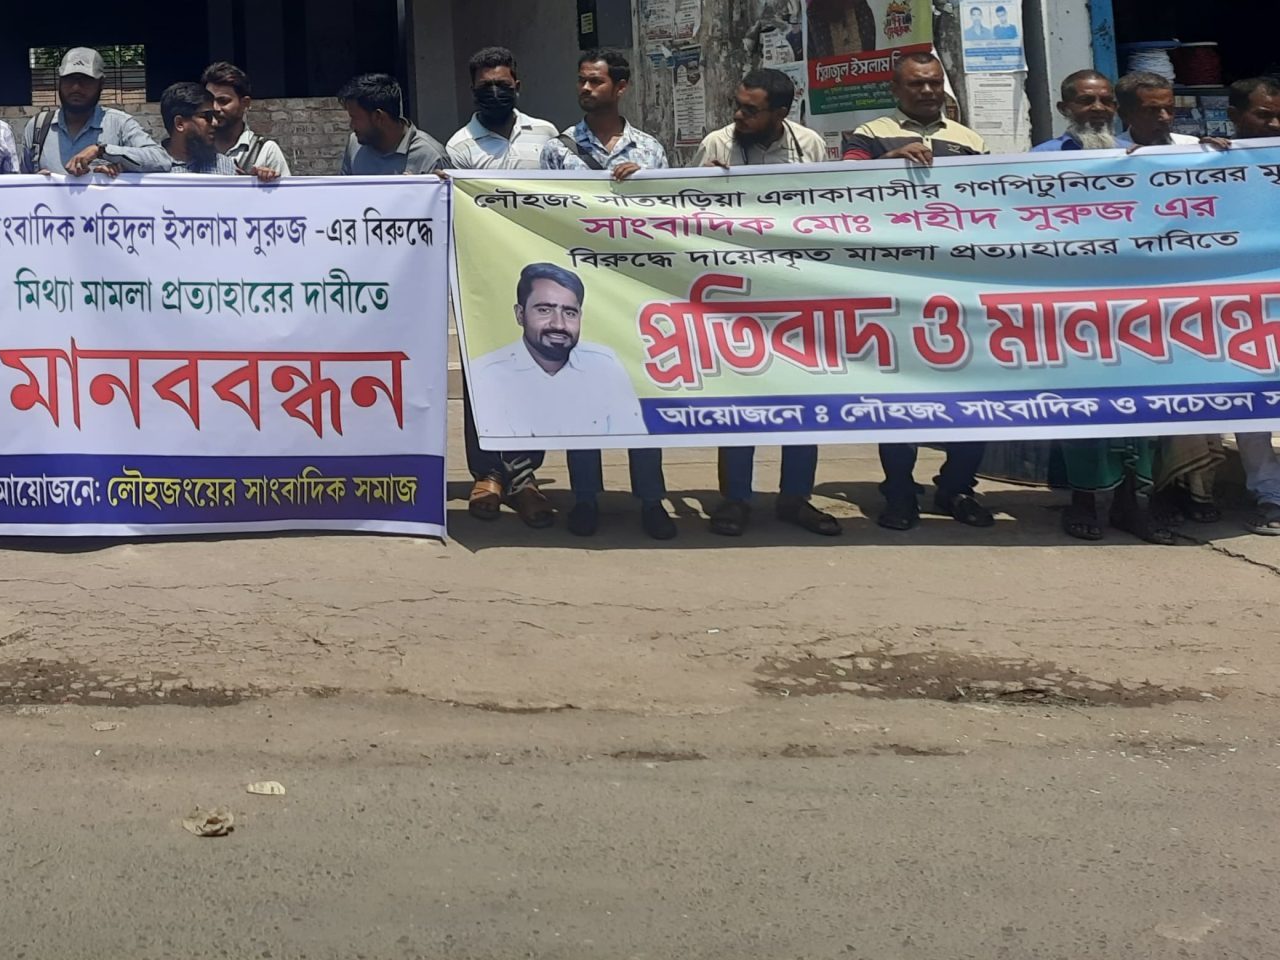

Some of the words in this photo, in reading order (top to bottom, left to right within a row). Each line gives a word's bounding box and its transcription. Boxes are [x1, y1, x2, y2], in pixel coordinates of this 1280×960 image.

[851, 57, 890, 77] ইসলাম
[474, 188, 587, 210] লৌহজং
[757, 179, 940, 208] এলাকাবাসীর
[955, 171, 1136, 198] গণপিটুনিতে
[1149, 166, 1248, 188] চোরের
[82, 203, 155, 256] শহিদুল
[162, 206, 236, 248] ইসলাম
[244, 214, 307, 256] সুরুজ
[363, 207, 433, 248] বিরুদ্ধে
[579, 212, 775, 239] সাংবাদিক
[793, 211, 872, 237] মোঃ
[886, 201, 1000, 232] শহীদ
[1014, 198, 1138, 232] সুরুজ
[1154, 194, 1220, 219] এর
[568, 246, 676, 269] বিরুদ্ধে
[689, 246, 833, 271] দায়েরকৃত
[846, 243, 940, 263] মামলা
[950, 238, 1119, 260] প্রত্যাহারের
[1129, 228, 1241, 253] দাবিতে
[15, 267, 73, 314] মিথ্যা
[81, 276, 152, 314] মামলা
[161, 278, 294, 316] প্রত্যাহারের
[300, 268, 389, 315] দাবীতে
[637, 272, 898, 390] প্রতিবাদ
[912, 293, 970, 372] ও
[978, 280, 1280, 378] মানববন্ধ
[656, 402, 806, 427] আয়োজনে
[841, 396, 953, 423] লৌহজং
[957, 393, 1099, 424] সাংবাদিক
[1109, 399, 1137, 415] ও
[1145, 392, 1255, 414] সচেতন
[108, 466, 237, 510] লৌহজংয়ের
[244, 467, 346, 508] সাংবাদিক
[355, 474, 418, 507] সমাজ
